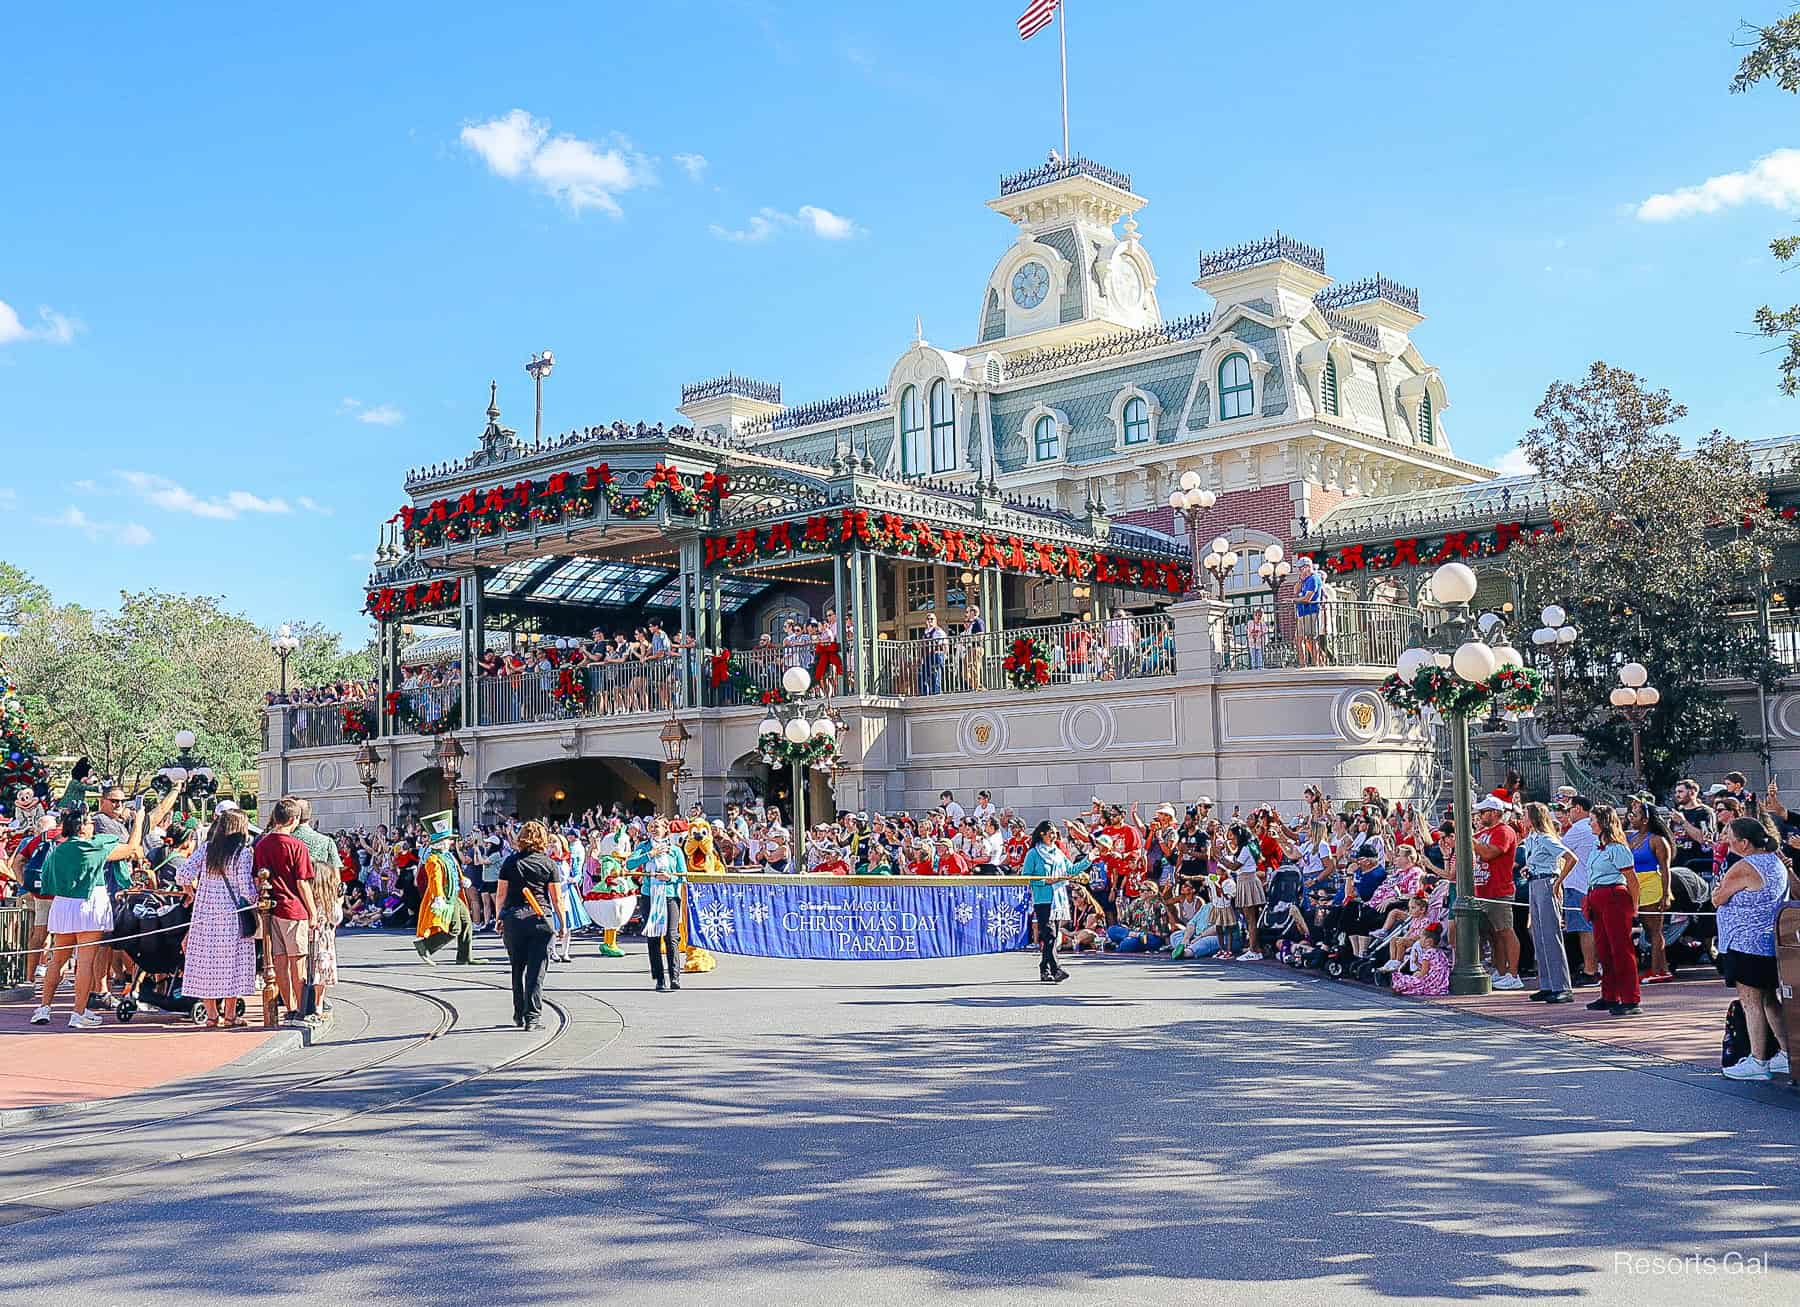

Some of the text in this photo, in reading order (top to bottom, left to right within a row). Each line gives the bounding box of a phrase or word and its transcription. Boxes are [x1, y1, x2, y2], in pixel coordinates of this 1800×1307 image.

[843, 899, 900, 912] MAGICAL
[782, 912, 940, 932] CHRISTMAS DAY
[838, 932, 917, 952] PARADE
